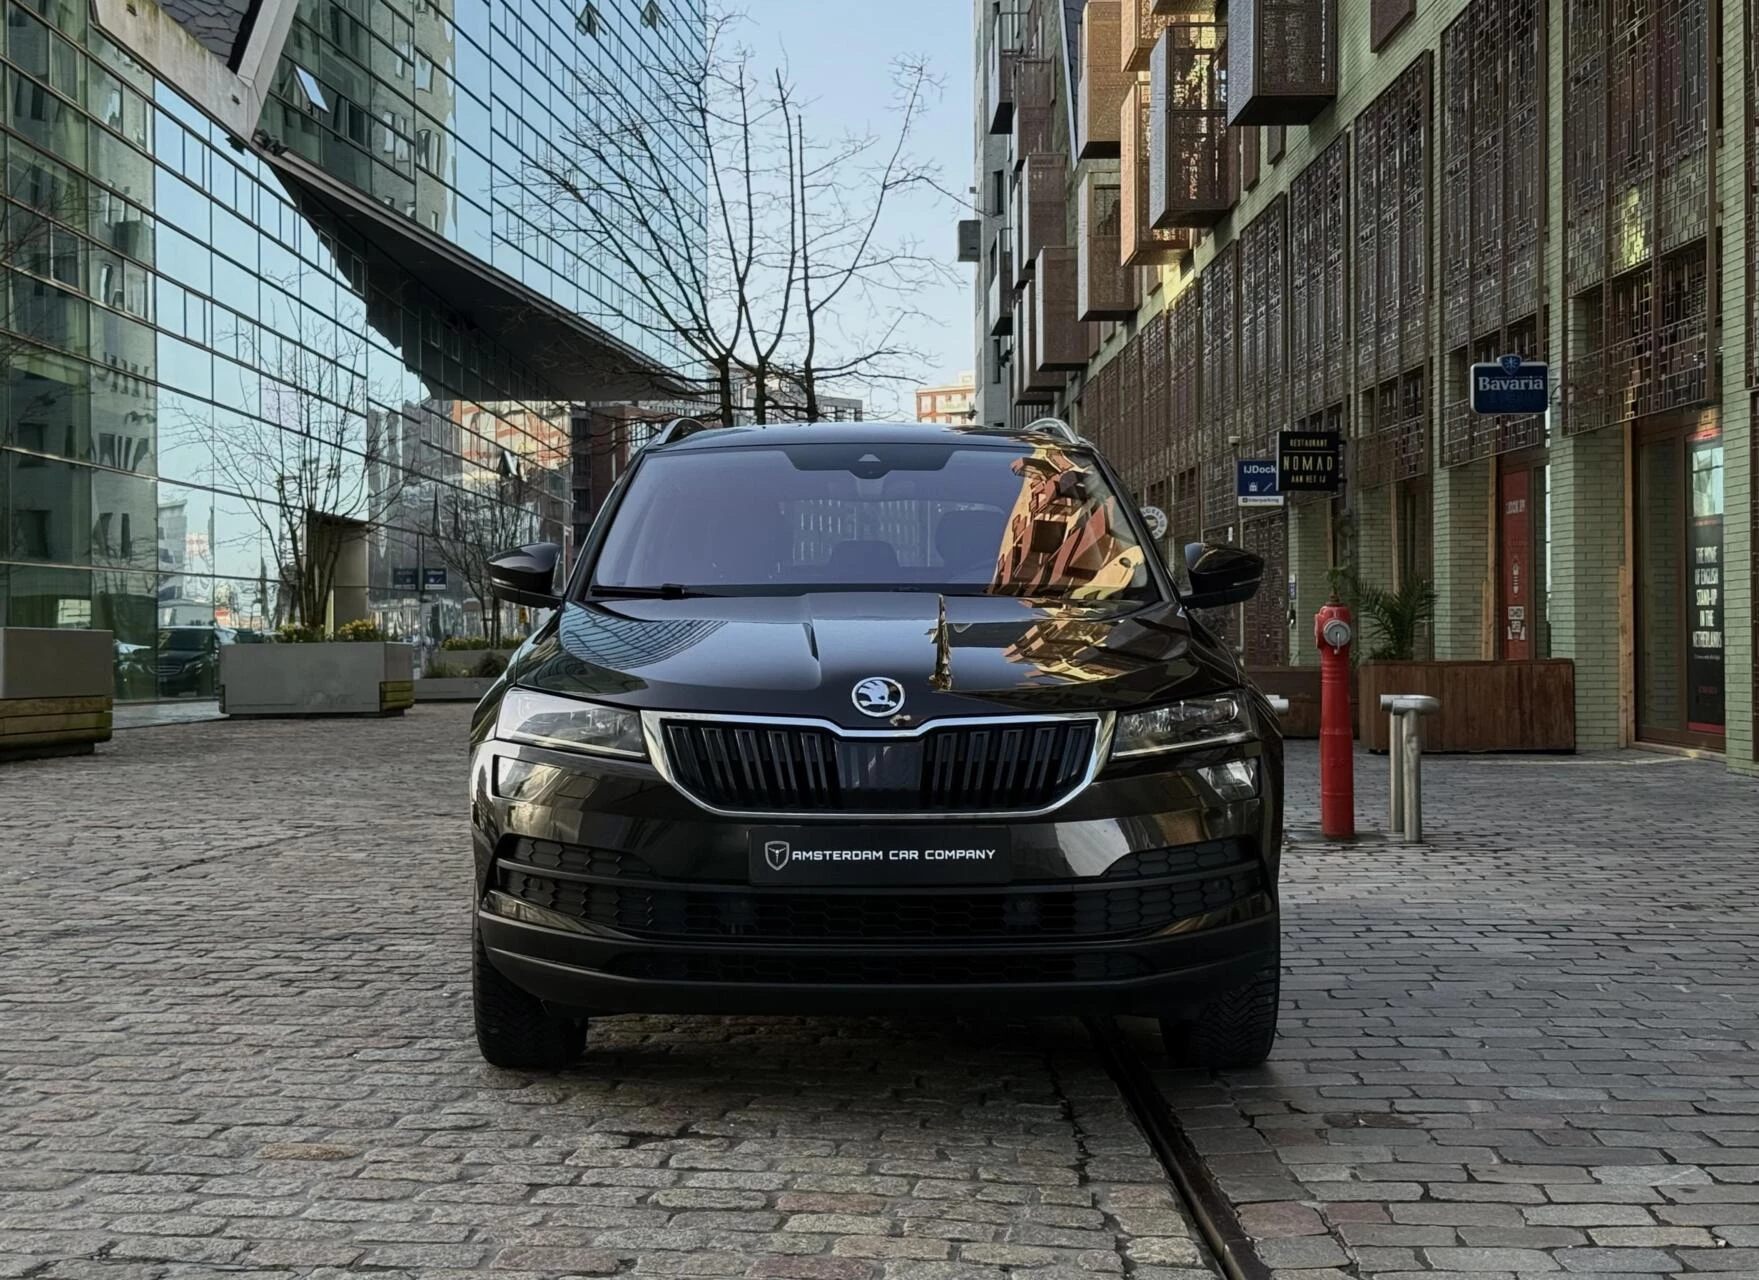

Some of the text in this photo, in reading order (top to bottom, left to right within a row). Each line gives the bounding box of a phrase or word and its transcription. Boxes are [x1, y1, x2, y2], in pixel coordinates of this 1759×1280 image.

[1478, 376, 1544, 391] Bavaria
[1290, 439, 1328, 448] RESTAURANT
[1283, 455, 1333, 471] NOMAD
[1243, 465, 1277, 474] IJDock
[1291, 475, 1303, 483] AAN
[1306, 475, 1317, 483] HET
[792, 849, 996, 861] AMSTERDAM CAR COMPANY
